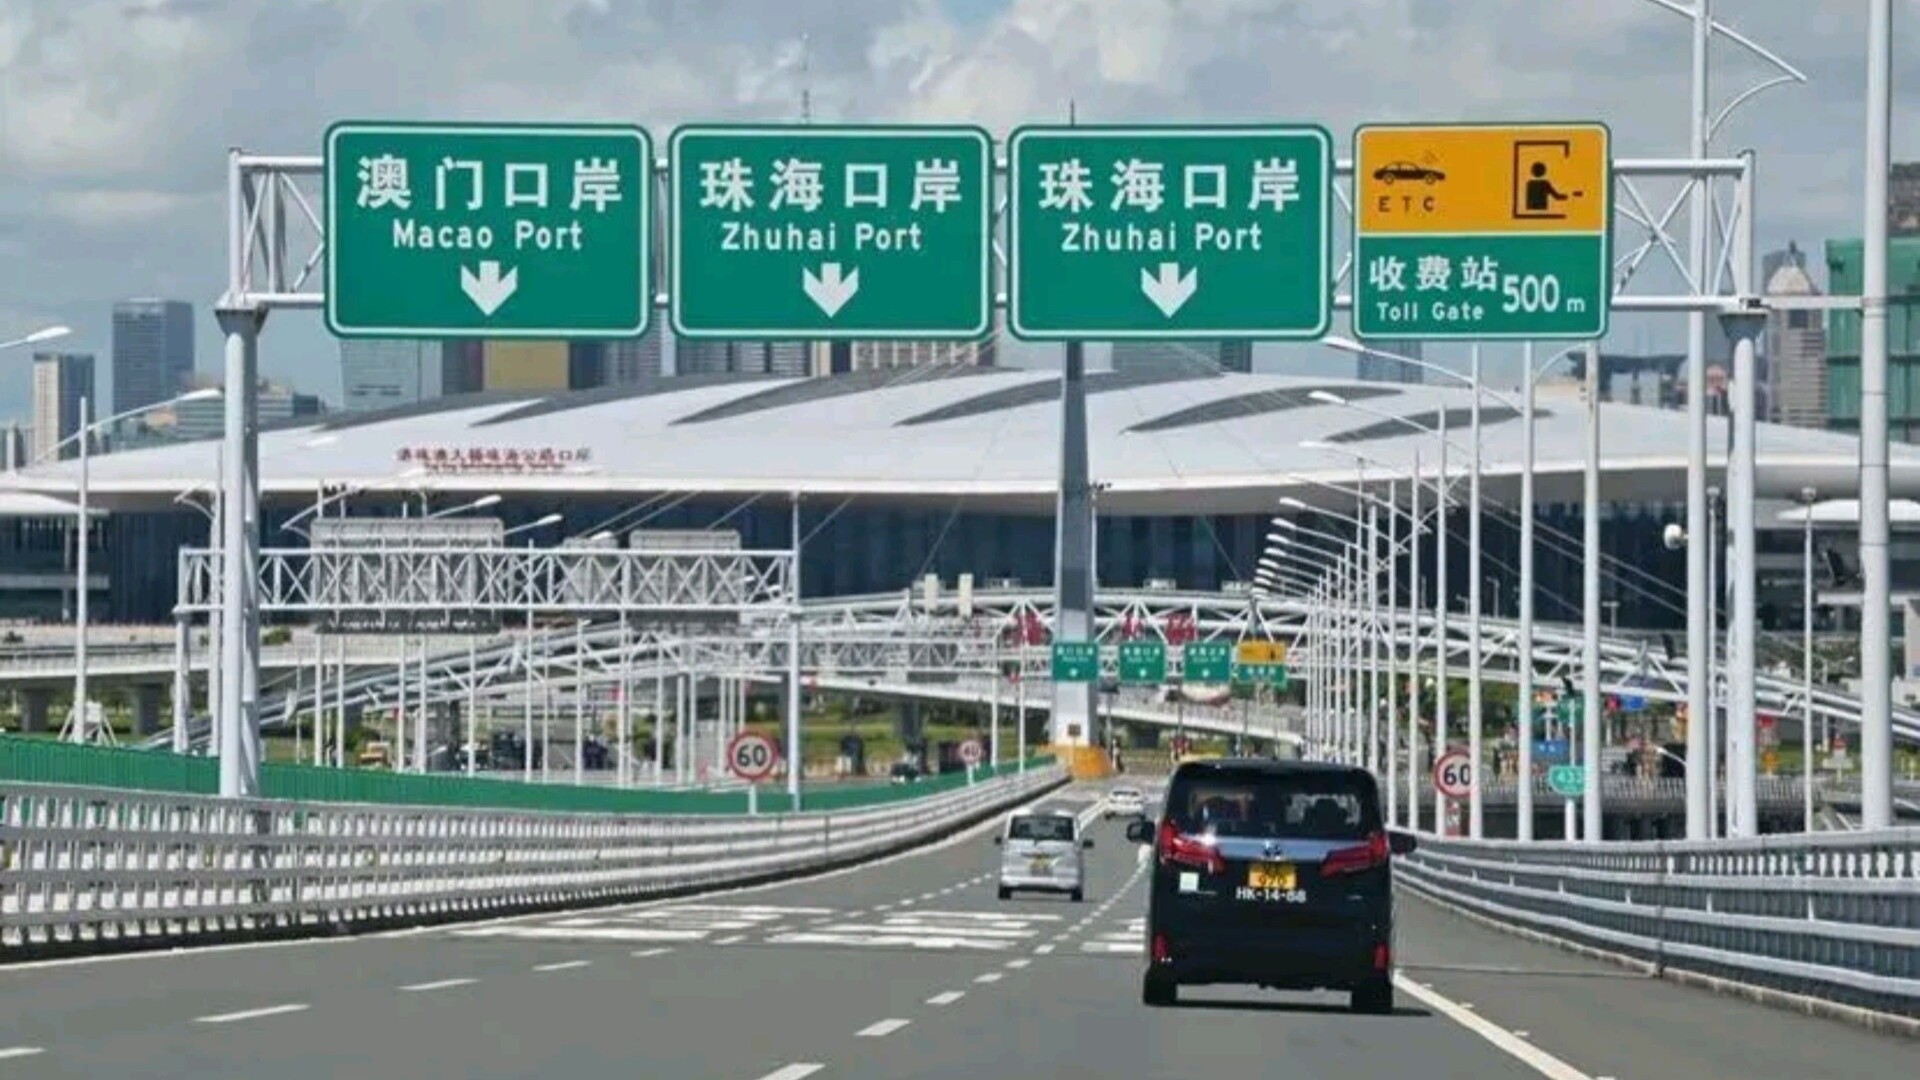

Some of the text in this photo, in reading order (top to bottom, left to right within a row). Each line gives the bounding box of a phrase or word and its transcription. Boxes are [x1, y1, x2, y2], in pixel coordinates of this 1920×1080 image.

[356, 154, 622, 211] 澳门口岸
[700, 157, 962, 213] 珠海口岸
[1039, 157, 1299, 212] 珠海口岸
[393, 219, 582, 249] Macao Port
[721, 222, 922, 250] Zhuhai Port
[1062, 222, 1262, 251] Zhuhai Port
[1369, 255, 1498, 292] 收费站
[1502, 274, 1559, 313] 500
[1377, 302, 1484, 321] Toll Gate
[736, 744, 767, 768] 60
[1443, 763, 1469, 787] 60
